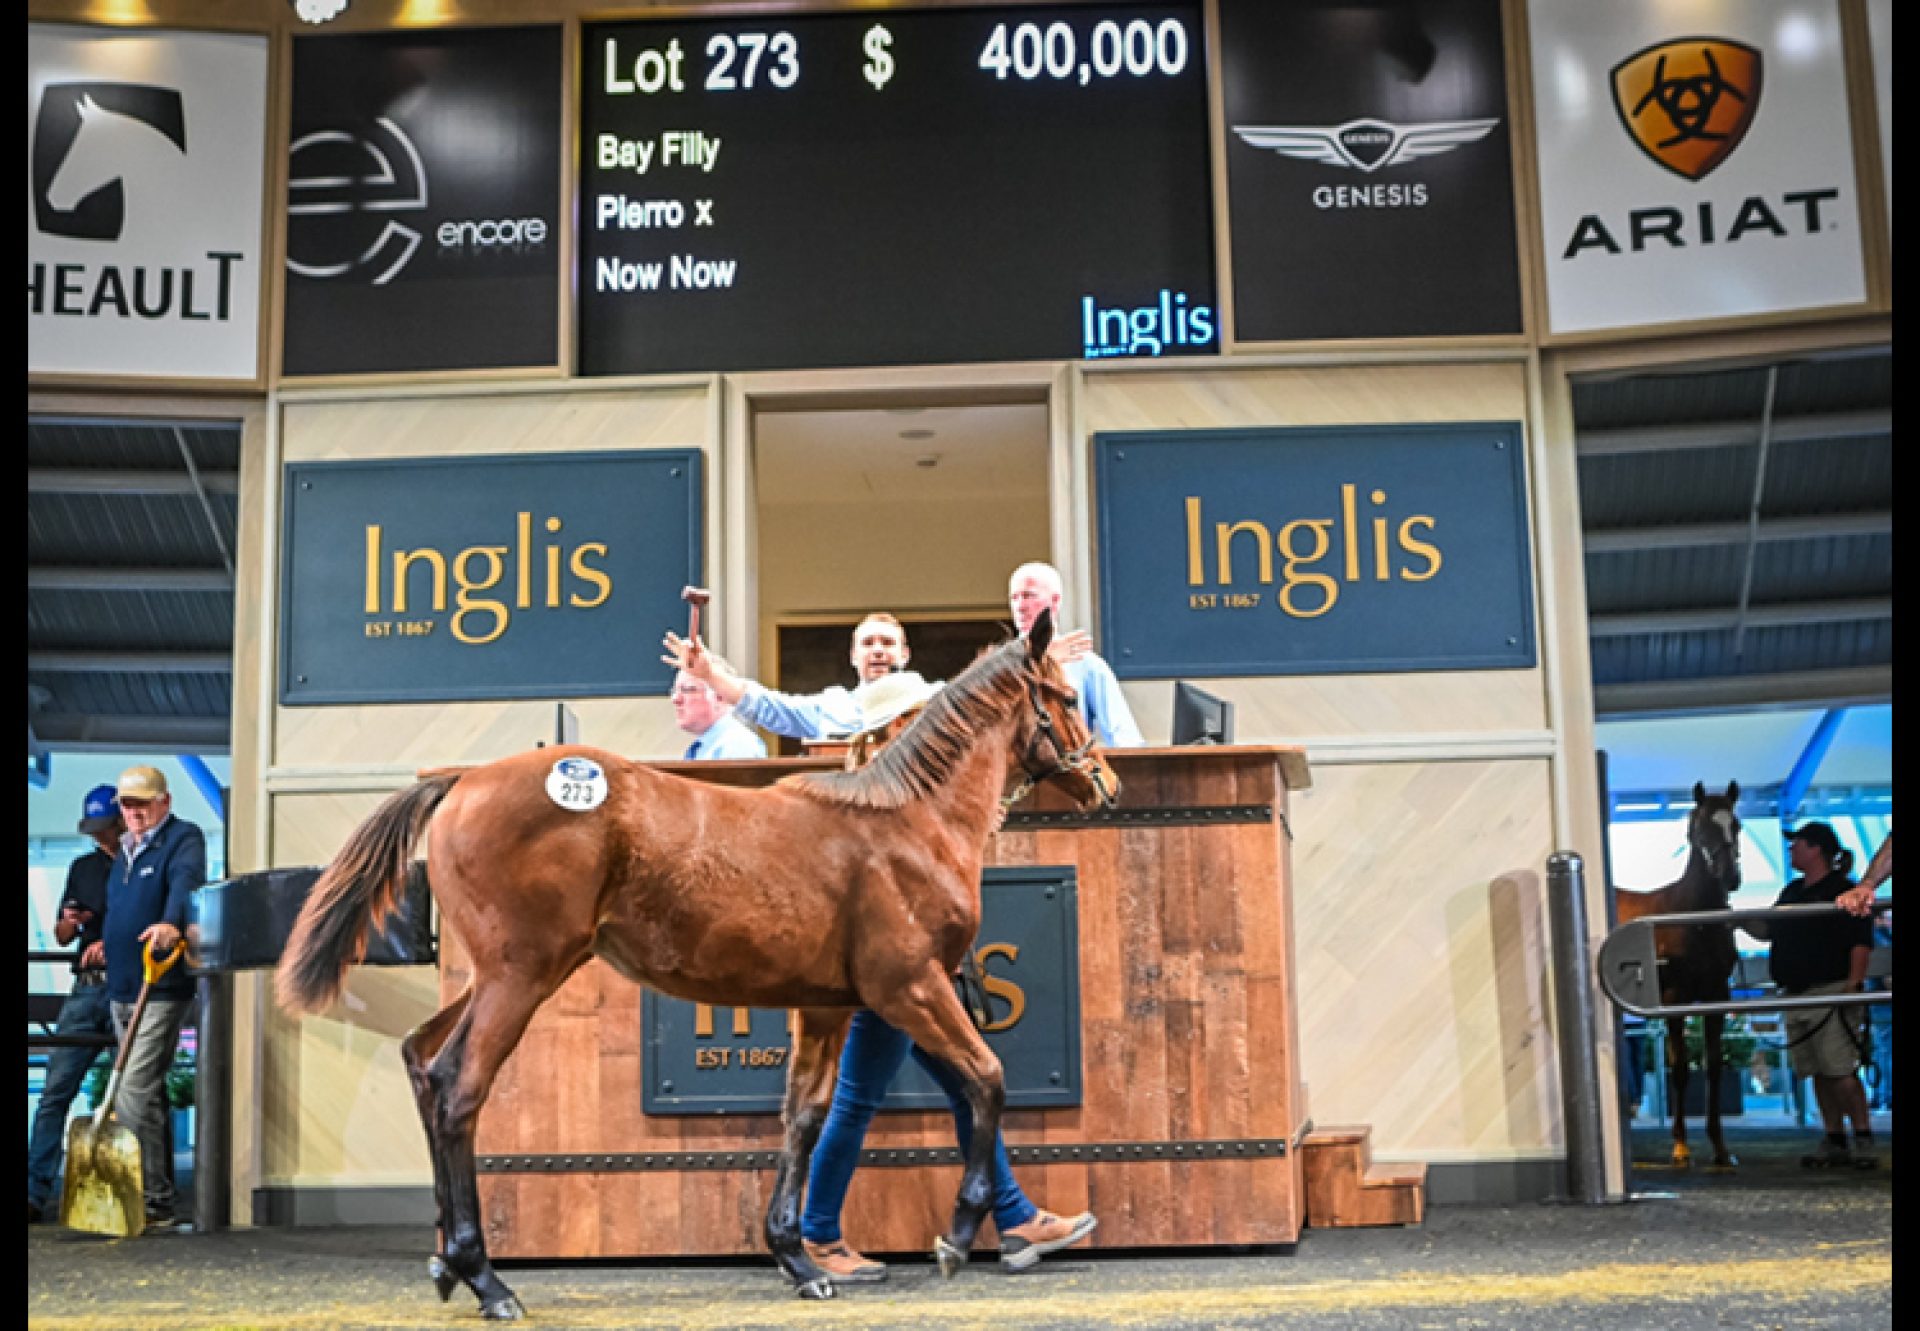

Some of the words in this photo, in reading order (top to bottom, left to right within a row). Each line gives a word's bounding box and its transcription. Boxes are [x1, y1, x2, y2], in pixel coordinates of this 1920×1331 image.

[604, 39, 685, 94] Lot
[705, 33, 800, 90] 273
[862, 24, 895, 90] $
[979, 19, 1189, 86] 400,000
[598, 132, 655, 174] Bay
[661, 130, 721, 172] Filly
[694, 199, 714, 226] x
[1312, 182, 1429, 209] GENESIS
[437, 217, 547, 247] encore
[1562, 187, 1840, 260] ARIAT
[597, 256, 663, 292] Now
[669, 253, 737, 289] Now
[1082, 288, 1214, 356] Inglis
[1185, 483, 1442, 619] Inglis
[364, 511, 612, 644] Inglis
[1189, 593, 1217, 609] EST
[365, 621, 393, 637] EST
[396, 620, 434, 636] 1867
[560, 782, 595, 804] 273
[695, 1046, 732, 1067] EST
[738, 1046, 788, 1067] 1867
